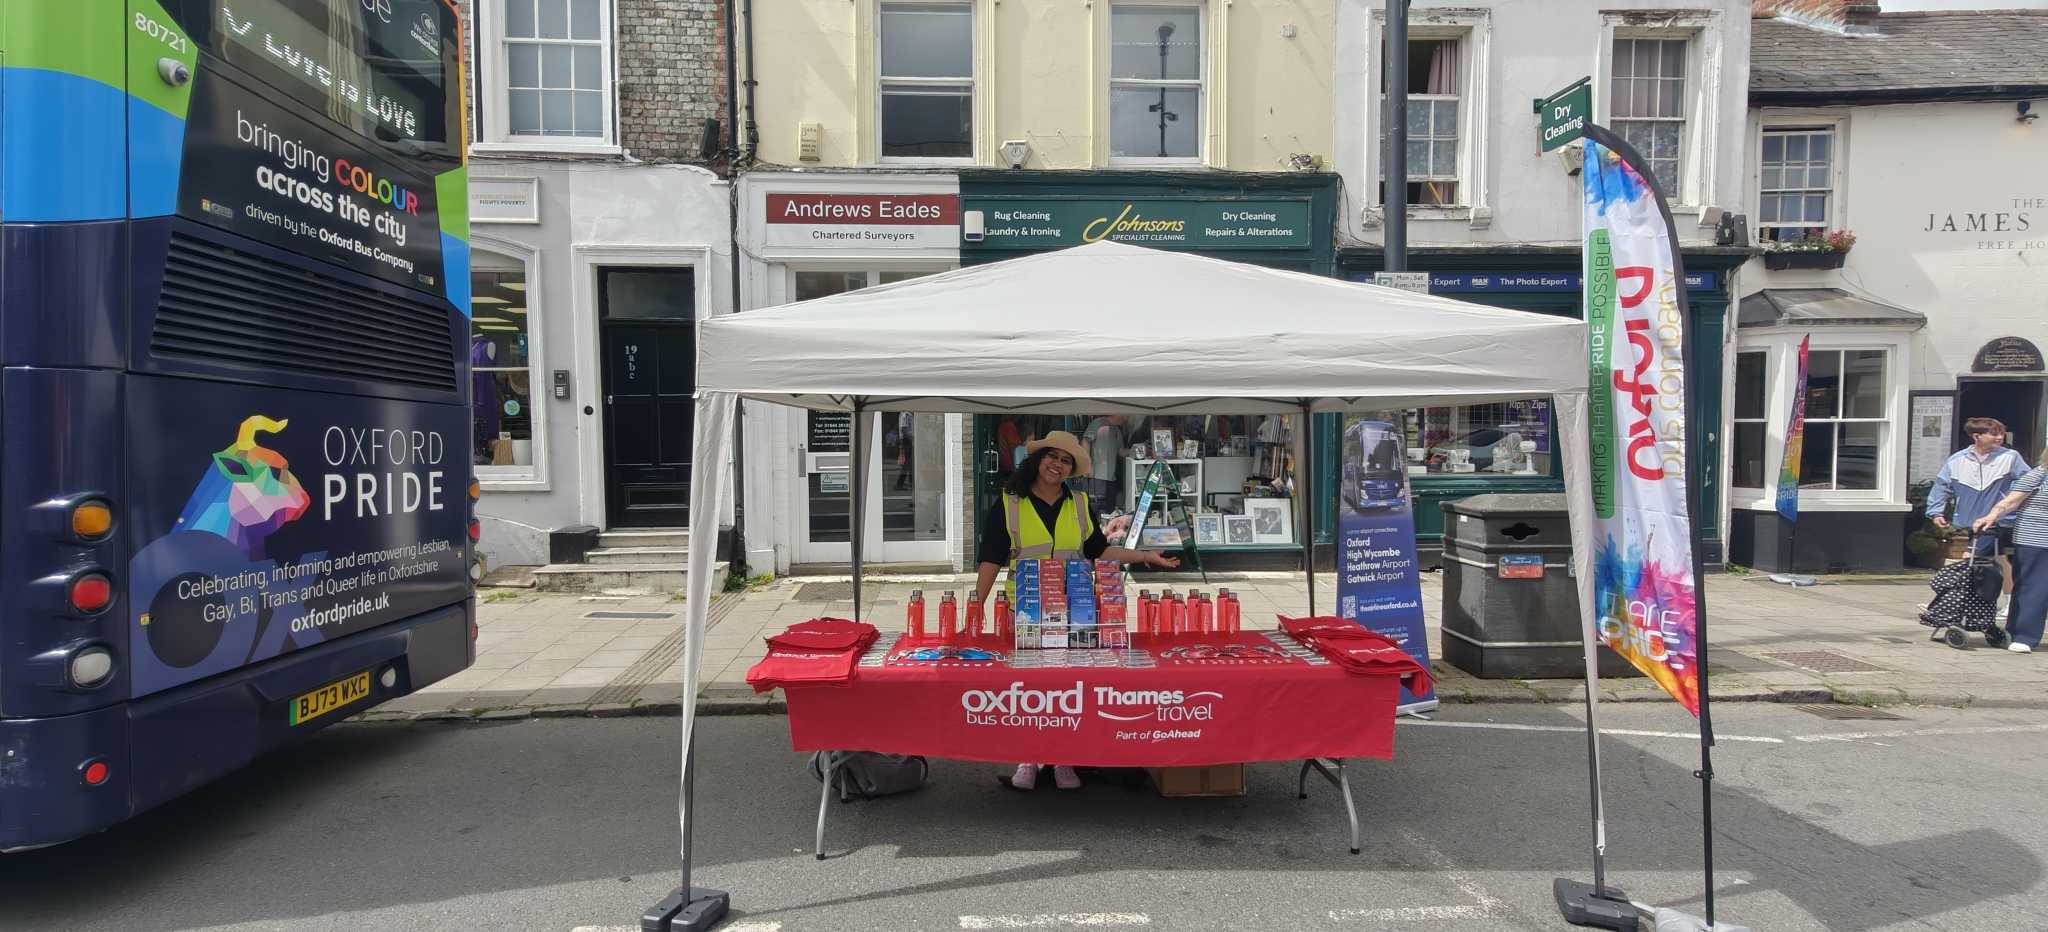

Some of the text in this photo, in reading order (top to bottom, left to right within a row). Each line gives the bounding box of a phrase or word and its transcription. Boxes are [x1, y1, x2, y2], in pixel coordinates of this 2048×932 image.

[134, 12, 187, 54] 80721
[366, 88, 416, 137] Love
[1554, 103, 1572, 121] Dry
[1544, 114, 1584, 142] Cleaning
[236, 109, 418, 217] bringing COLOUR
[256, 165, 335, 214] across
[337, 193, 371, 228] the
[374, 211, 406, 247] city
[784, 199, 941, 219] Andrews Eades
[2011, 198, 2046, 209] THE
[994, 210, 1051, 223] Rug Cleaning
[1082, 204, 1186, 244] Johnsons
[1222, 211, 1277, 223] Dry Cleaning
[1924, 212, 2030, 232] JAMES
[245, 202, 282, 227] driven
[284, 214, 298, 236] by
[300, 221, 318, 239] the
[319, 228, 353, 251] Oxford
[354, 240, 373, 258] Bus
[373, 247, 415, 274] Company
[812, 230, 915, 243] Chartered Surveyors
[984, 227, 1061, 240] Laundry & Ironing
[1111, 234, 1186, 242] SPECIALIST CLEANING
[1205, 226, 1294, 239] Repairs & Alterations
[1977, 239, 2048, 250] FREE HO
[1434, 278, 1461, 288] Expert
[1500, 278, 1568, 288] The Photo Expert
[1592, 235, 1611, 319] POSSIBLE
[624, 344, 638, 355] 19
[1531, 399, 1547, 412] Zips
[324, 425, 444, 467] OXFORD
[1592, 443, 1609, 513] MAKING
[324, 470, 444, 521] PRIDE
[1346, 537, 1371, 548] Oxford
[1346, 547, 1401, 561] High Wycombe
[177, 537, 452, 601] Celebrating, informing and empowering Lesbian,
[1347, 559, 1410, 572] Heathrow Airport
[1347, 571, 1404, 584] Gatwick Airport
[203, 559, 439, 624] Gay, Bi, Trans and Queer life in Oxfordshire
[291, 591, 391, 633] oxfordpride.uk
[300, 675, 367, 719] BJ73 WXC
[961, 680, 1084, 715] oxford
[1094, 686, 1185, 706] Thames
[967, 712, 1082, 731] bus company
[1157, 703, 1213, 722] travel
[1115, 729, 1201, 741] Part of GoAhead
